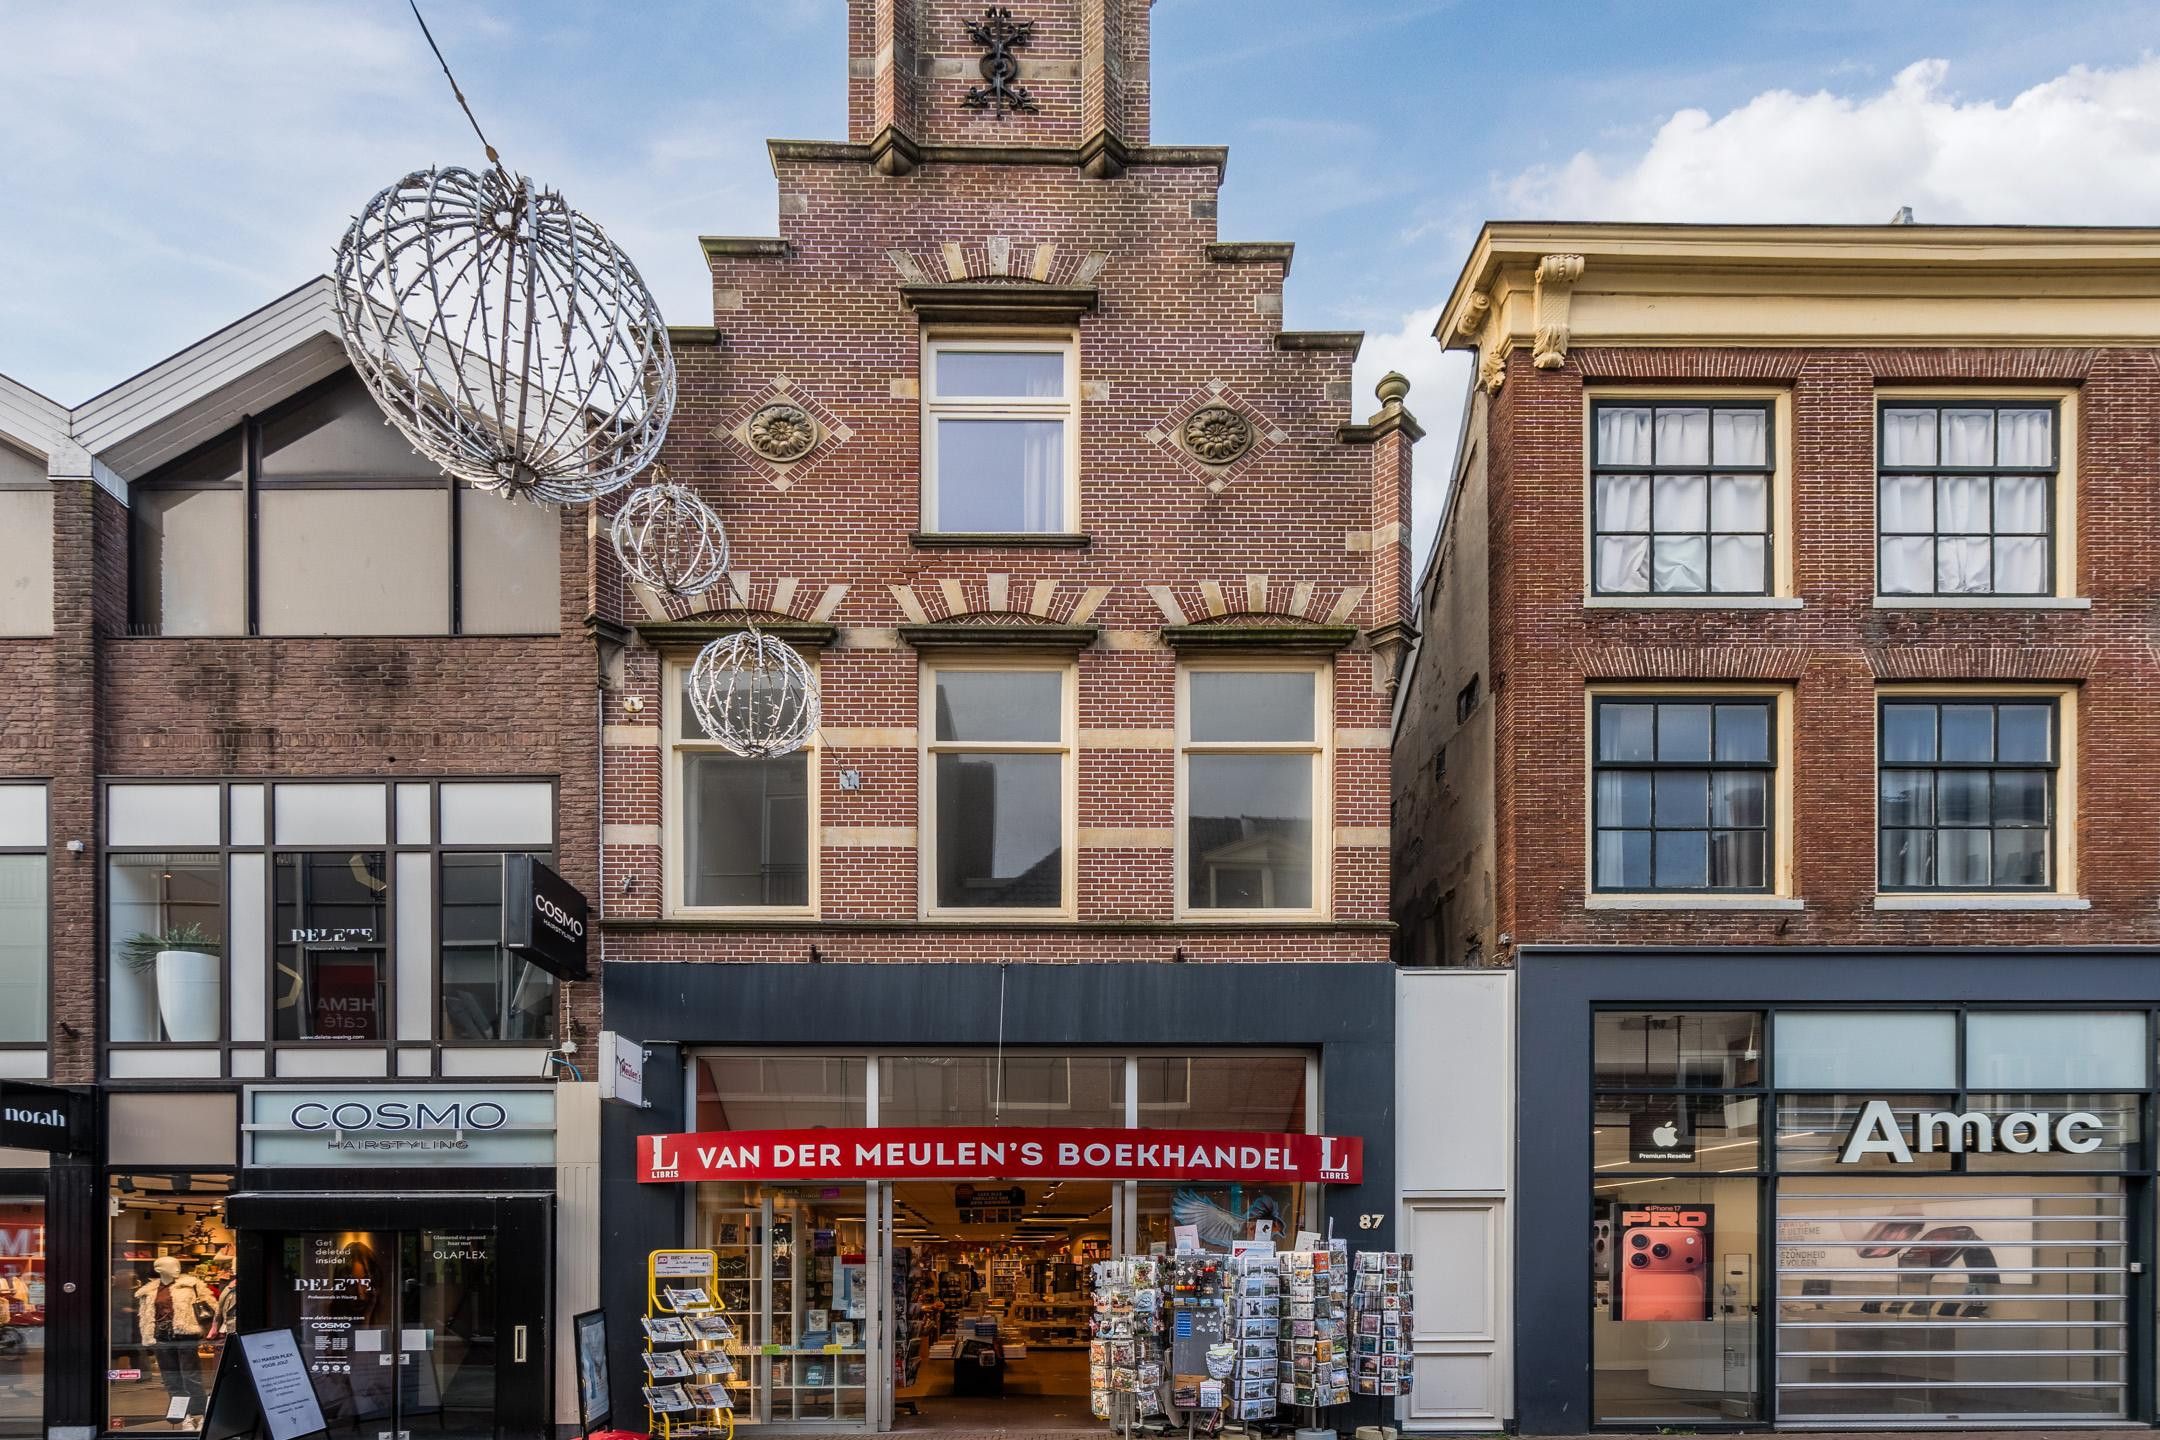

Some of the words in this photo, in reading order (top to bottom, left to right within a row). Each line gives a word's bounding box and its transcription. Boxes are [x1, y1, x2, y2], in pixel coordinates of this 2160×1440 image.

[535, 894, 583, 937] COSMO
[291, 928, 373, 942] DELETE
[5, 1108, 65, 1127] norah
[290, 1102, 508, 1131] COSMO
[1836, 1100, 2104, 1164] Amac
[327, 1140, 469, 1150] HAIRSTYLING
[697, 1145, 760, 1169] VAN
[773, 1144, 841, 1167] DER
[855, 1142, 1043, 1167] MEULEN'S
[1058, 1143, 1298, 1170] BOEKHANDEL
[651, 1170, 679, 1178] LIBRIS
[1320, 1171, 1350, 1180] LIBRIS
[1359, 1214, 1385, 1229] 87
[1622, 1211, 1707, 1227] PRO
[1780, 1251, 1826, 1259] EZONDHEID
[294, 1279, 372, 1291] DELETE
